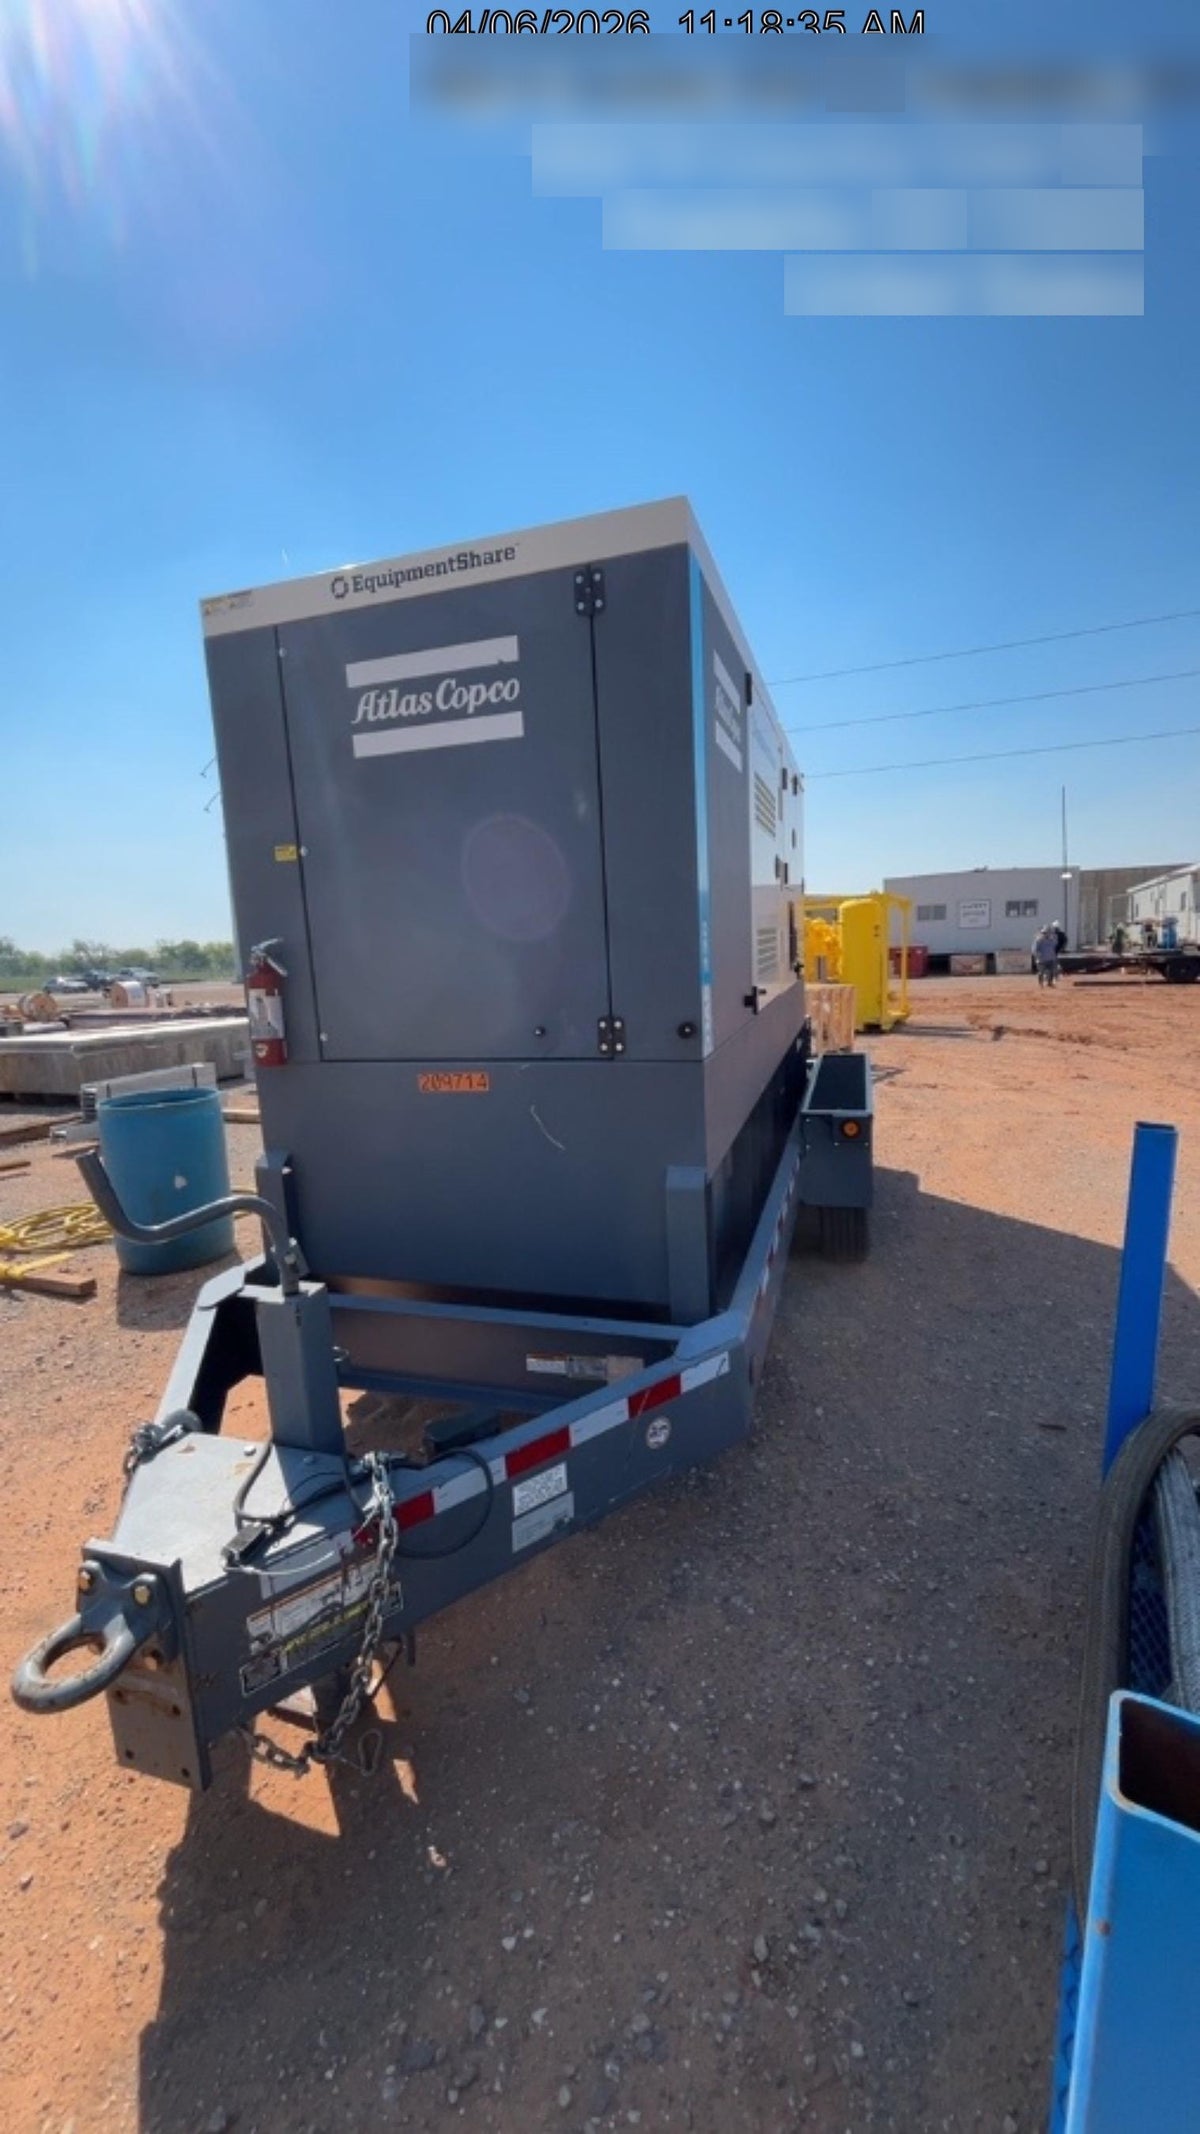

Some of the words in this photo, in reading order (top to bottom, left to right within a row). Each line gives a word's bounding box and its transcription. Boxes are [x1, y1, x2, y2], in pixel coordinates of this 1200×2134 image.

[352, 546, 516, 593] EquipmentShare
[351, 688, 432, 725] Atlas
[435, 677, 520, 714] Copco
